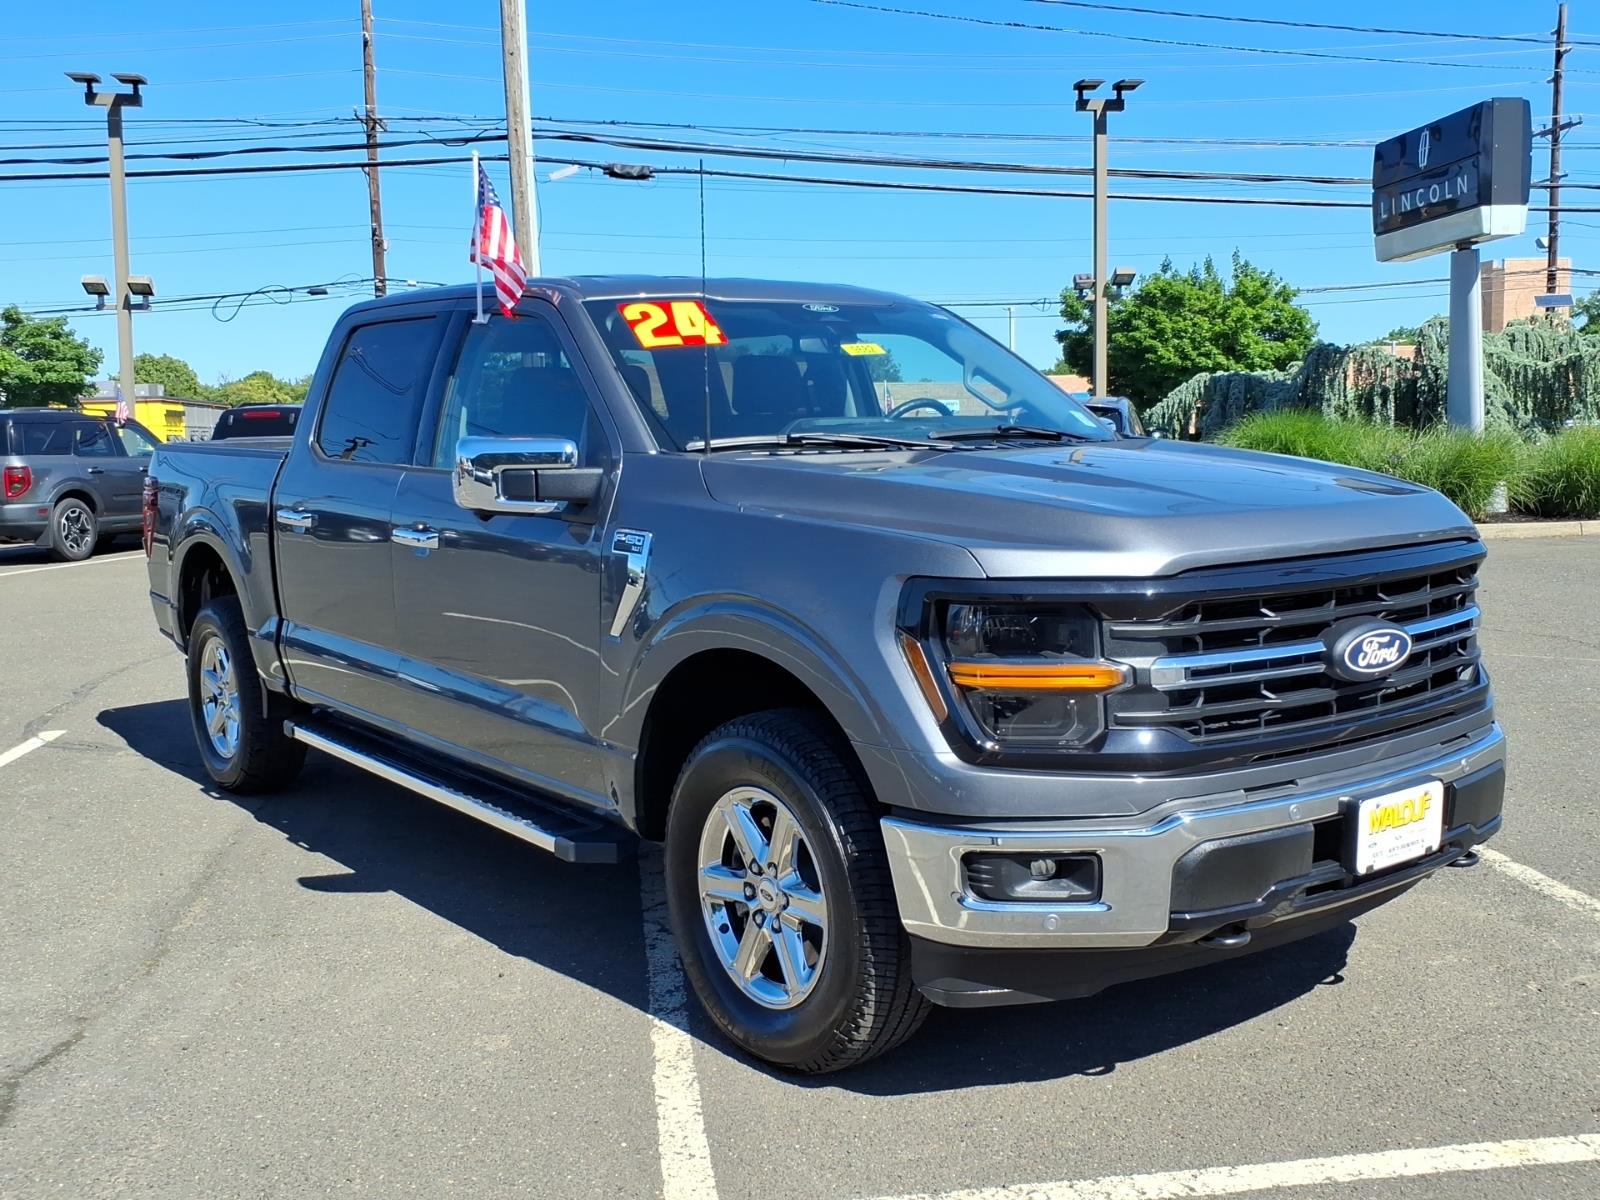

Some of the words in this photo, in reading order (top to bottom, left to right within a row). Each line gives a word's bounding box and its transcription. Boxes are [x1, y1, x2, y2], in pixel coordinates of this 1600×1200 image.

[1381, 174, 1468, 218] LINCOLN
[622, 302, 722, 348] 24
[1358, 636, 1400, 667] Ford
[1369, 793, 1432, 835] MALOUF
